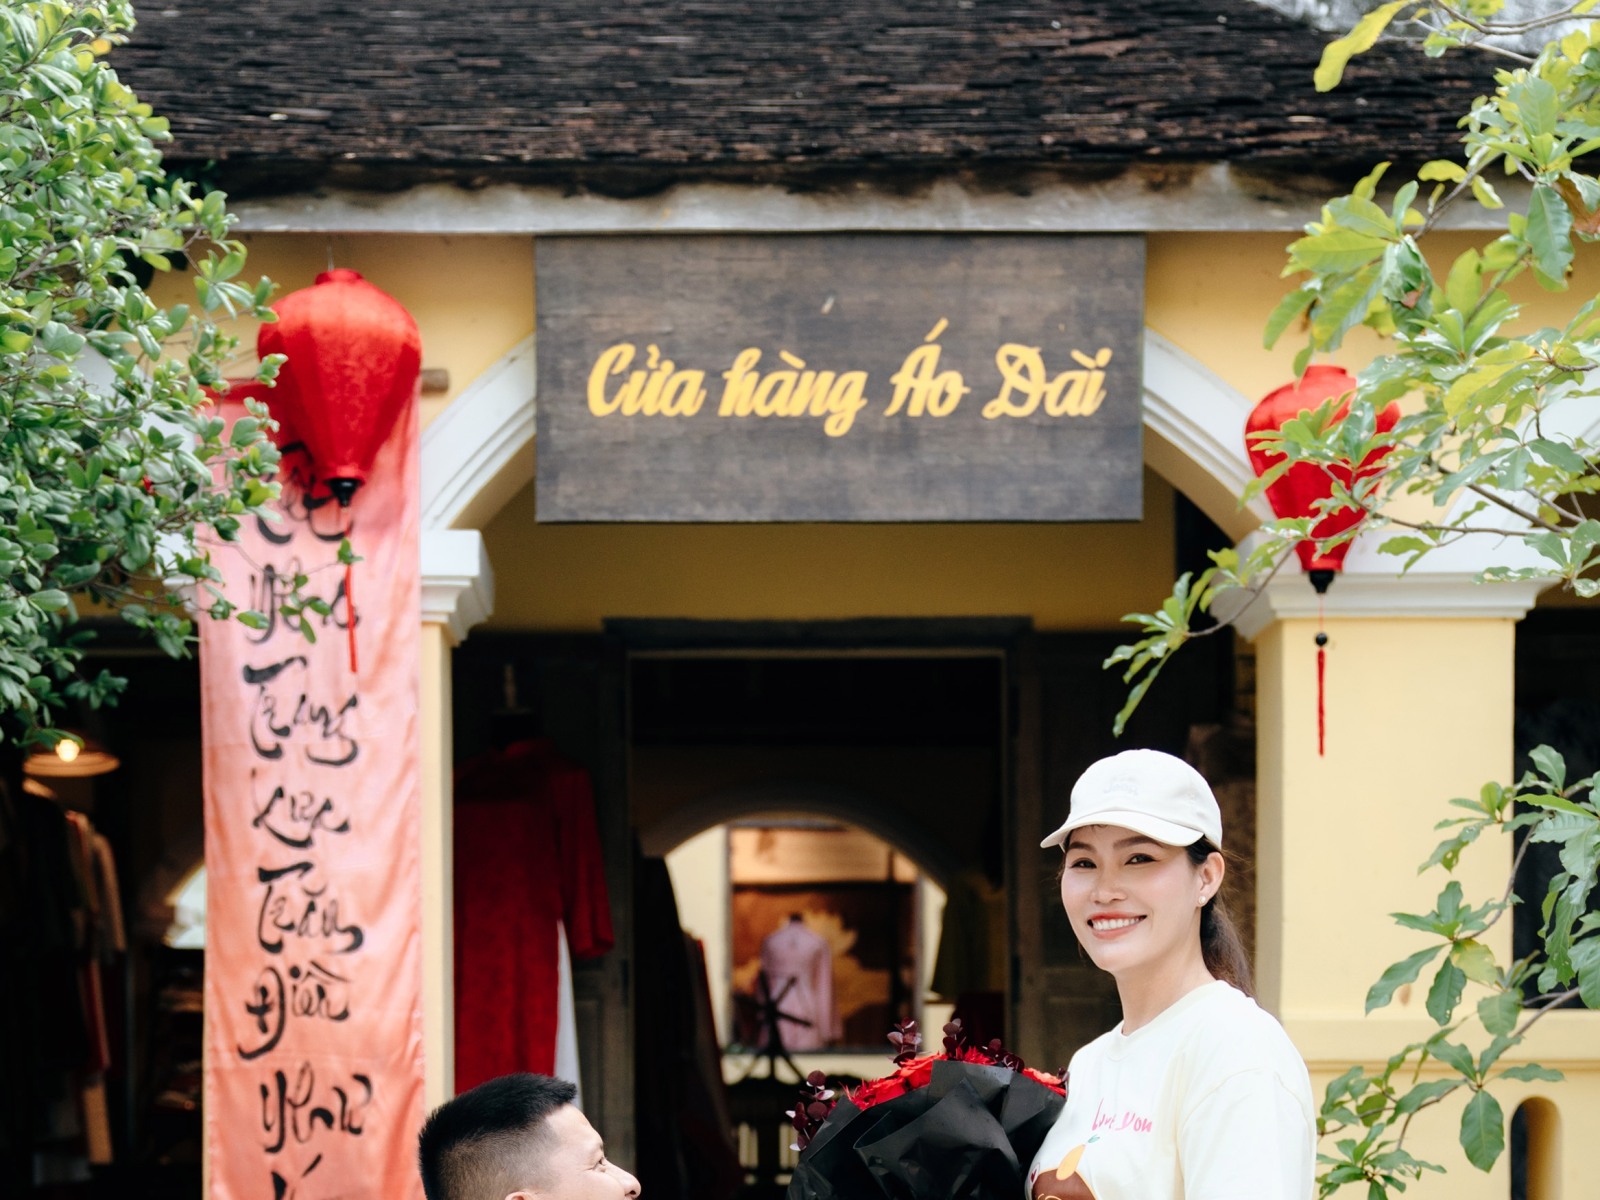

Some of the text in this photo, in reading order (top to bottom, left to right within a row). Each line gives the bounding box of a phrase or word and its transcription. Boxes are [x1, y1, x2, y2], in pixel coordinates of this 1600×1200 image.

[587, 318, 1113, 437] Cửa hàng Áo Dài
[237, 960, 351, 1060] Điều
[259, 1060, 373, 1153] Như
